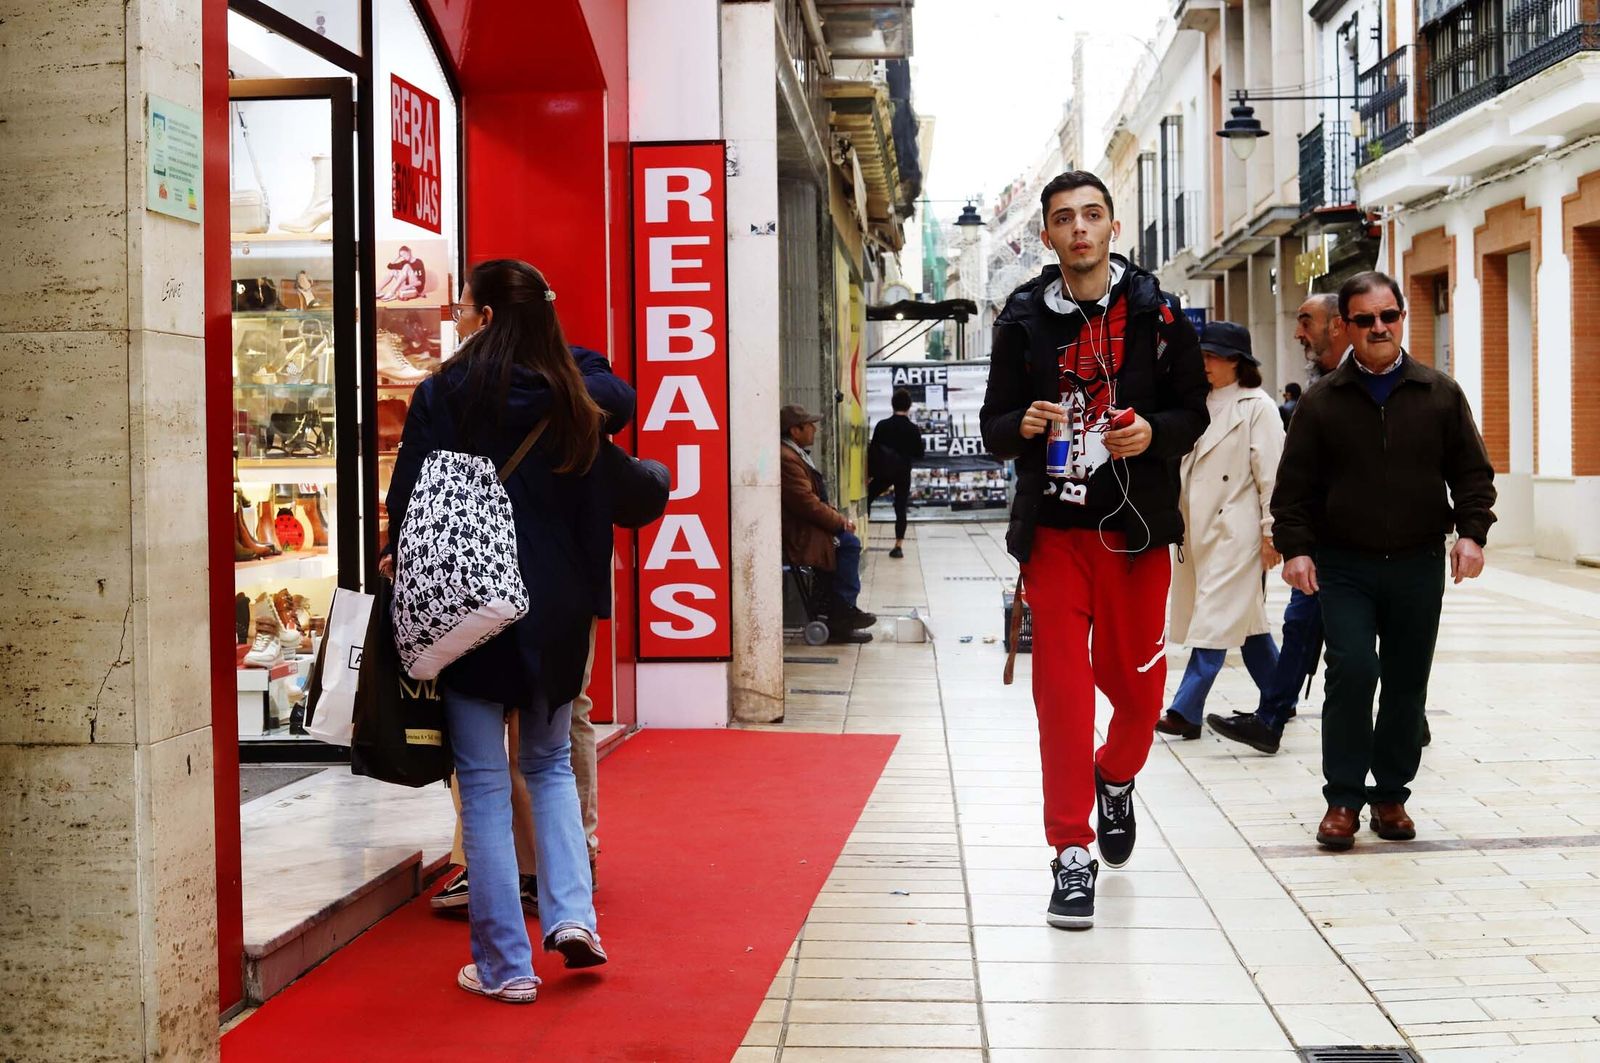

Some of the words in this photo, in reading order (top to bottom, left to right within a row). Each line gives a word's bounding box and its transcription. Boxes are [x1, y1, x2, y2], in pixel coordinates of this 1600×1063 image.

[392, 82, 438, 177] REBA
[416, 175, 439, 226] JAS
[893, 367, 948, 386] ARTE
[642, 167, 721, 640] REBAJAS
[921, 434, 948, 452] TE
